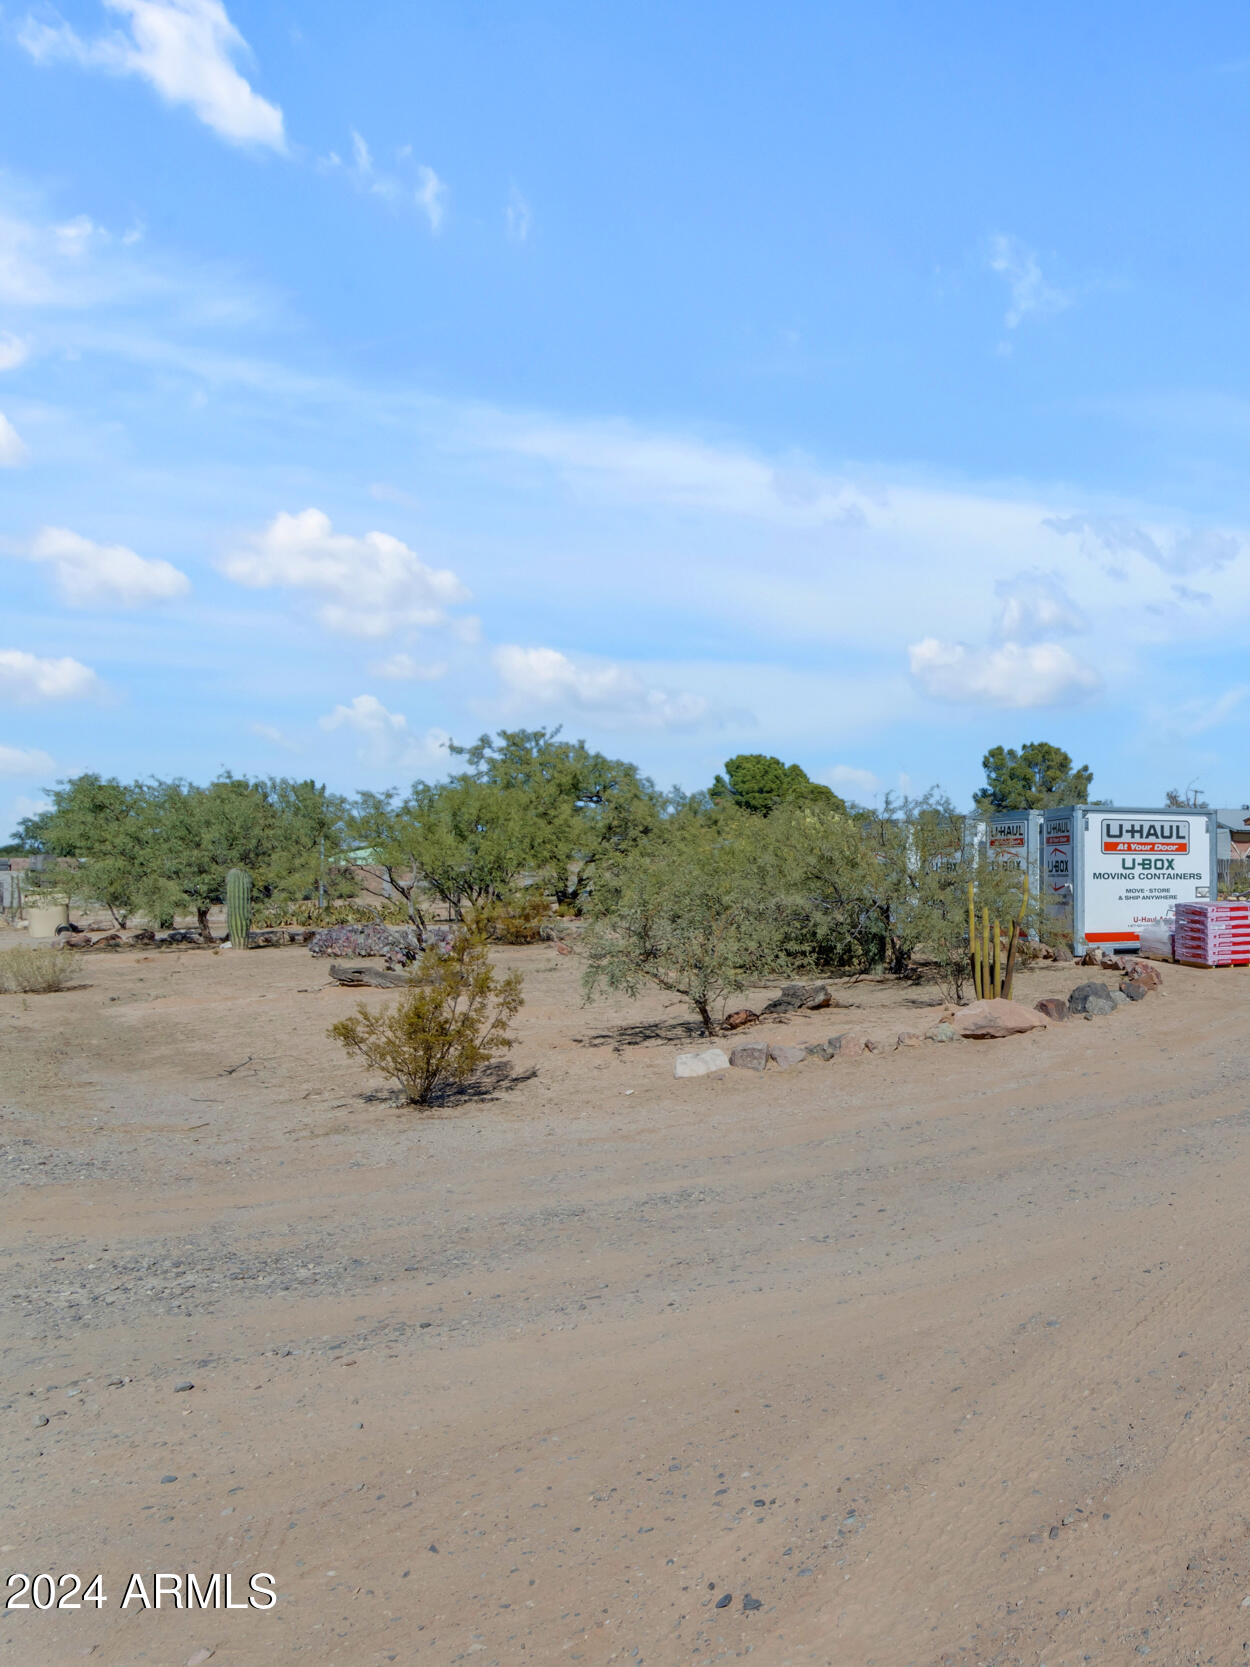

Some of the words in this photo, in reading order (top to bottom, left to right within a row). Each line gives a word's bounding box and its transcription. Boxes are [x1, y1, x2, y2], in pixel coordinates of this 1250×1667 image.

[1047, 821, 1070, 835] U-HAUL
[1105, 823, 1186, 840] U-HAUL
[1116, 843, 1128, 851] At
[1130, 843, 1152, 851] Your
[1154, 843, 1179, 851] Door
[1048, 859, 1069, 873] U-BOX
[1121, 858, 1175, 871] U-BOX
[1092, 872, 1135, 881] MOVING
[1138, 872, 1203, 881] CONTAINERS
